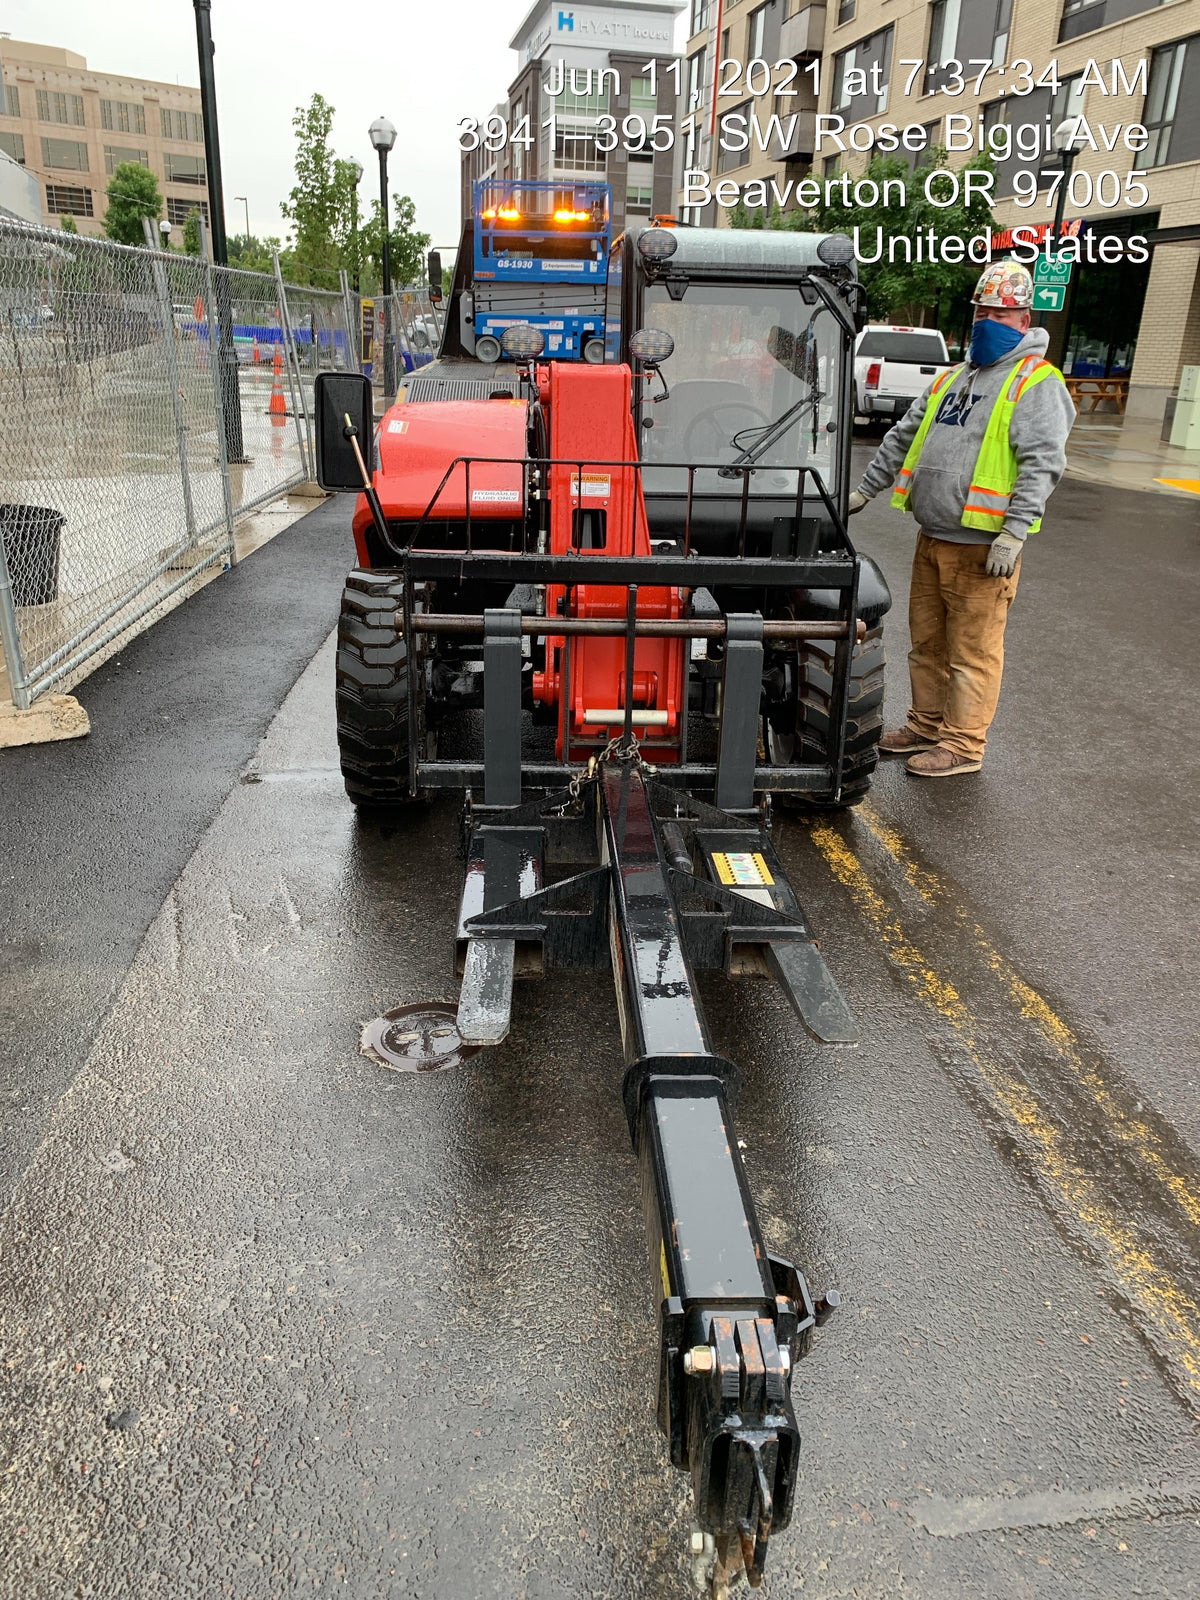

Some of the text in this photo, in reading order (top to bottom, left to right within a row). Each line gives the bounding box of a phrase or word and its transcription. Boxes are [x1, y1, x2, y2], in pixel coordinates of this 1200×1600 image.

[579, 19, 631, 36] HYATT
[633, 25, 670, 41] house
[497, 260, 533, 269] GS-1930
[935, 392, 983, 427] CAT
